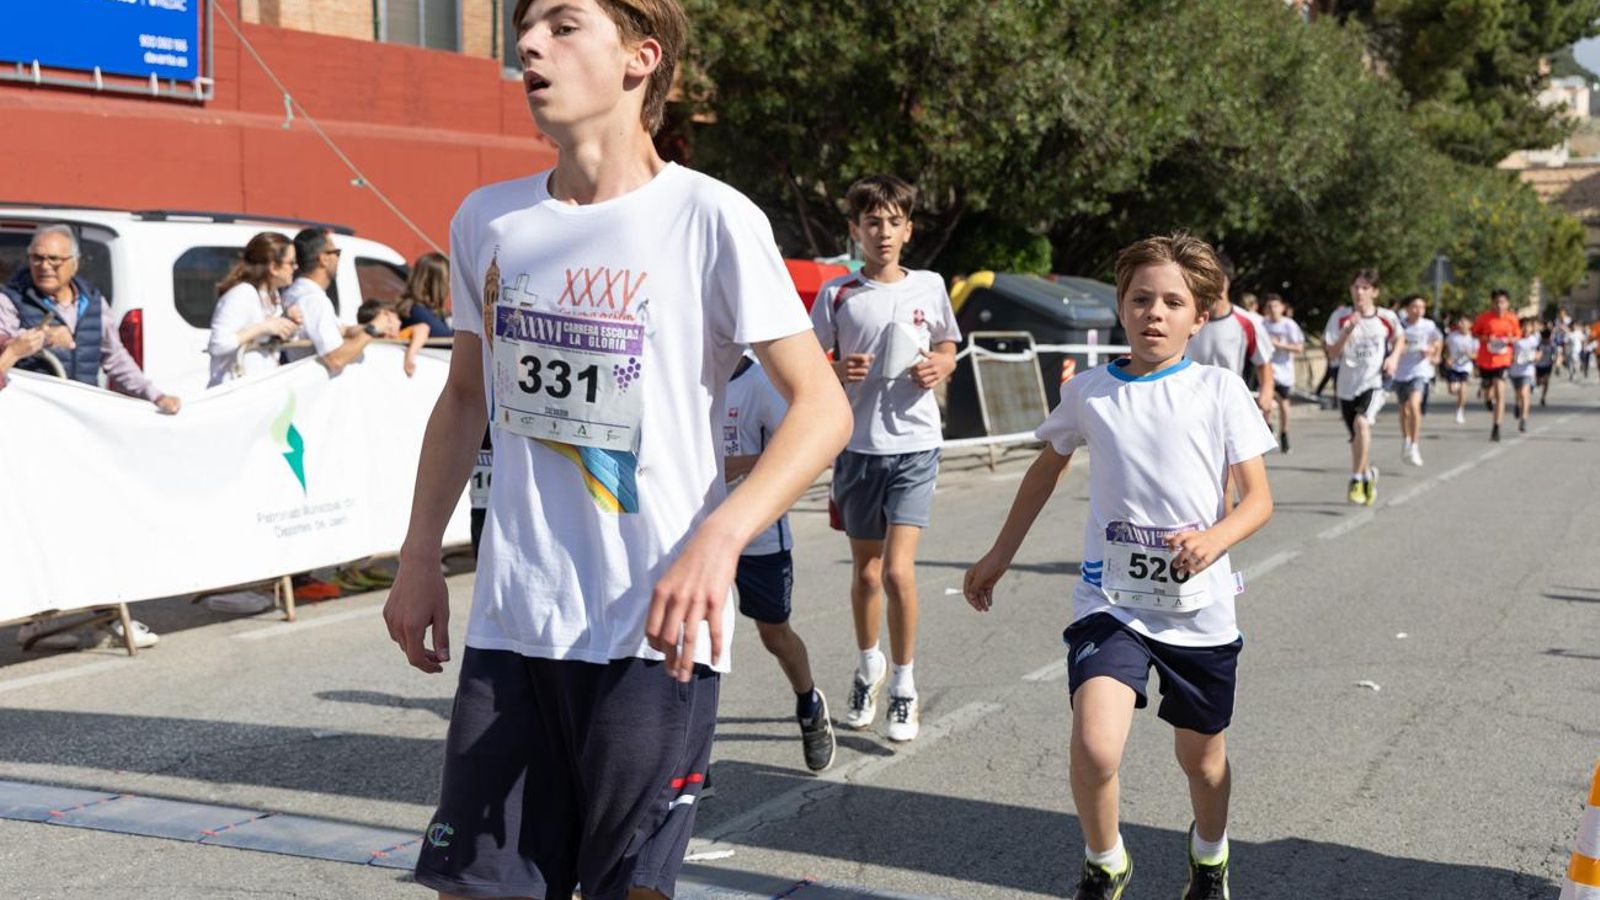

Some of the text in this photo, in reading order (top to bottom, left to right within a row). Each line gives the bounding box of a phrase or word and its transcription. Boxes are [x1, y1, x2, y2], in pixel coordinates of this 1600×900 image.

[558, 267, 647, 312] XXXV
[563, 322, 598, 336] CARRERA
[570, 335, 626, 350] LA GLORIA
[519, 355, 598, 403] 331
